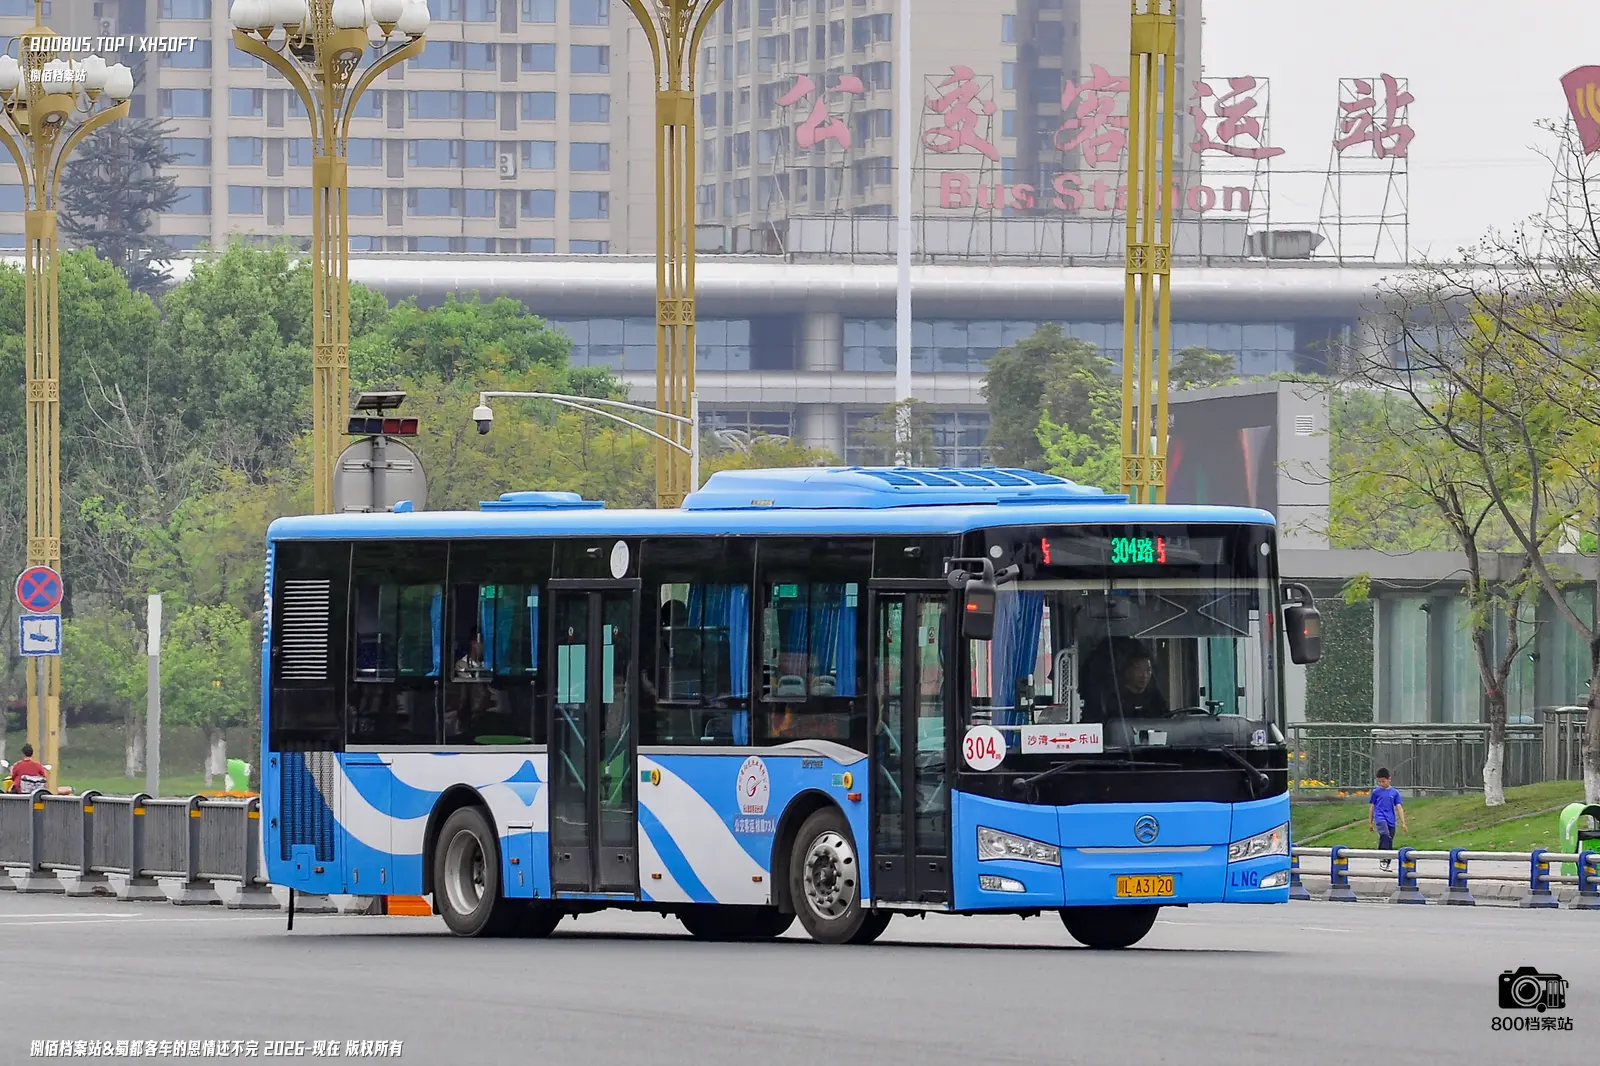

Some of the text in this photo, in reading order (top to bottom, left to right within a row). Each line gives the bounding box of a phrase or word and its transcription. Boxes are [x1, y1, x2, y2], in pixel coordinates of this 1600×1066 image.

[939, 171, 1036, 211] Bus
[1111, 537, 1155, 563] 304路
[1027, 733, 1099, 746] 沙湾 乐山
[1231, 871, 1258, 886] LNG
